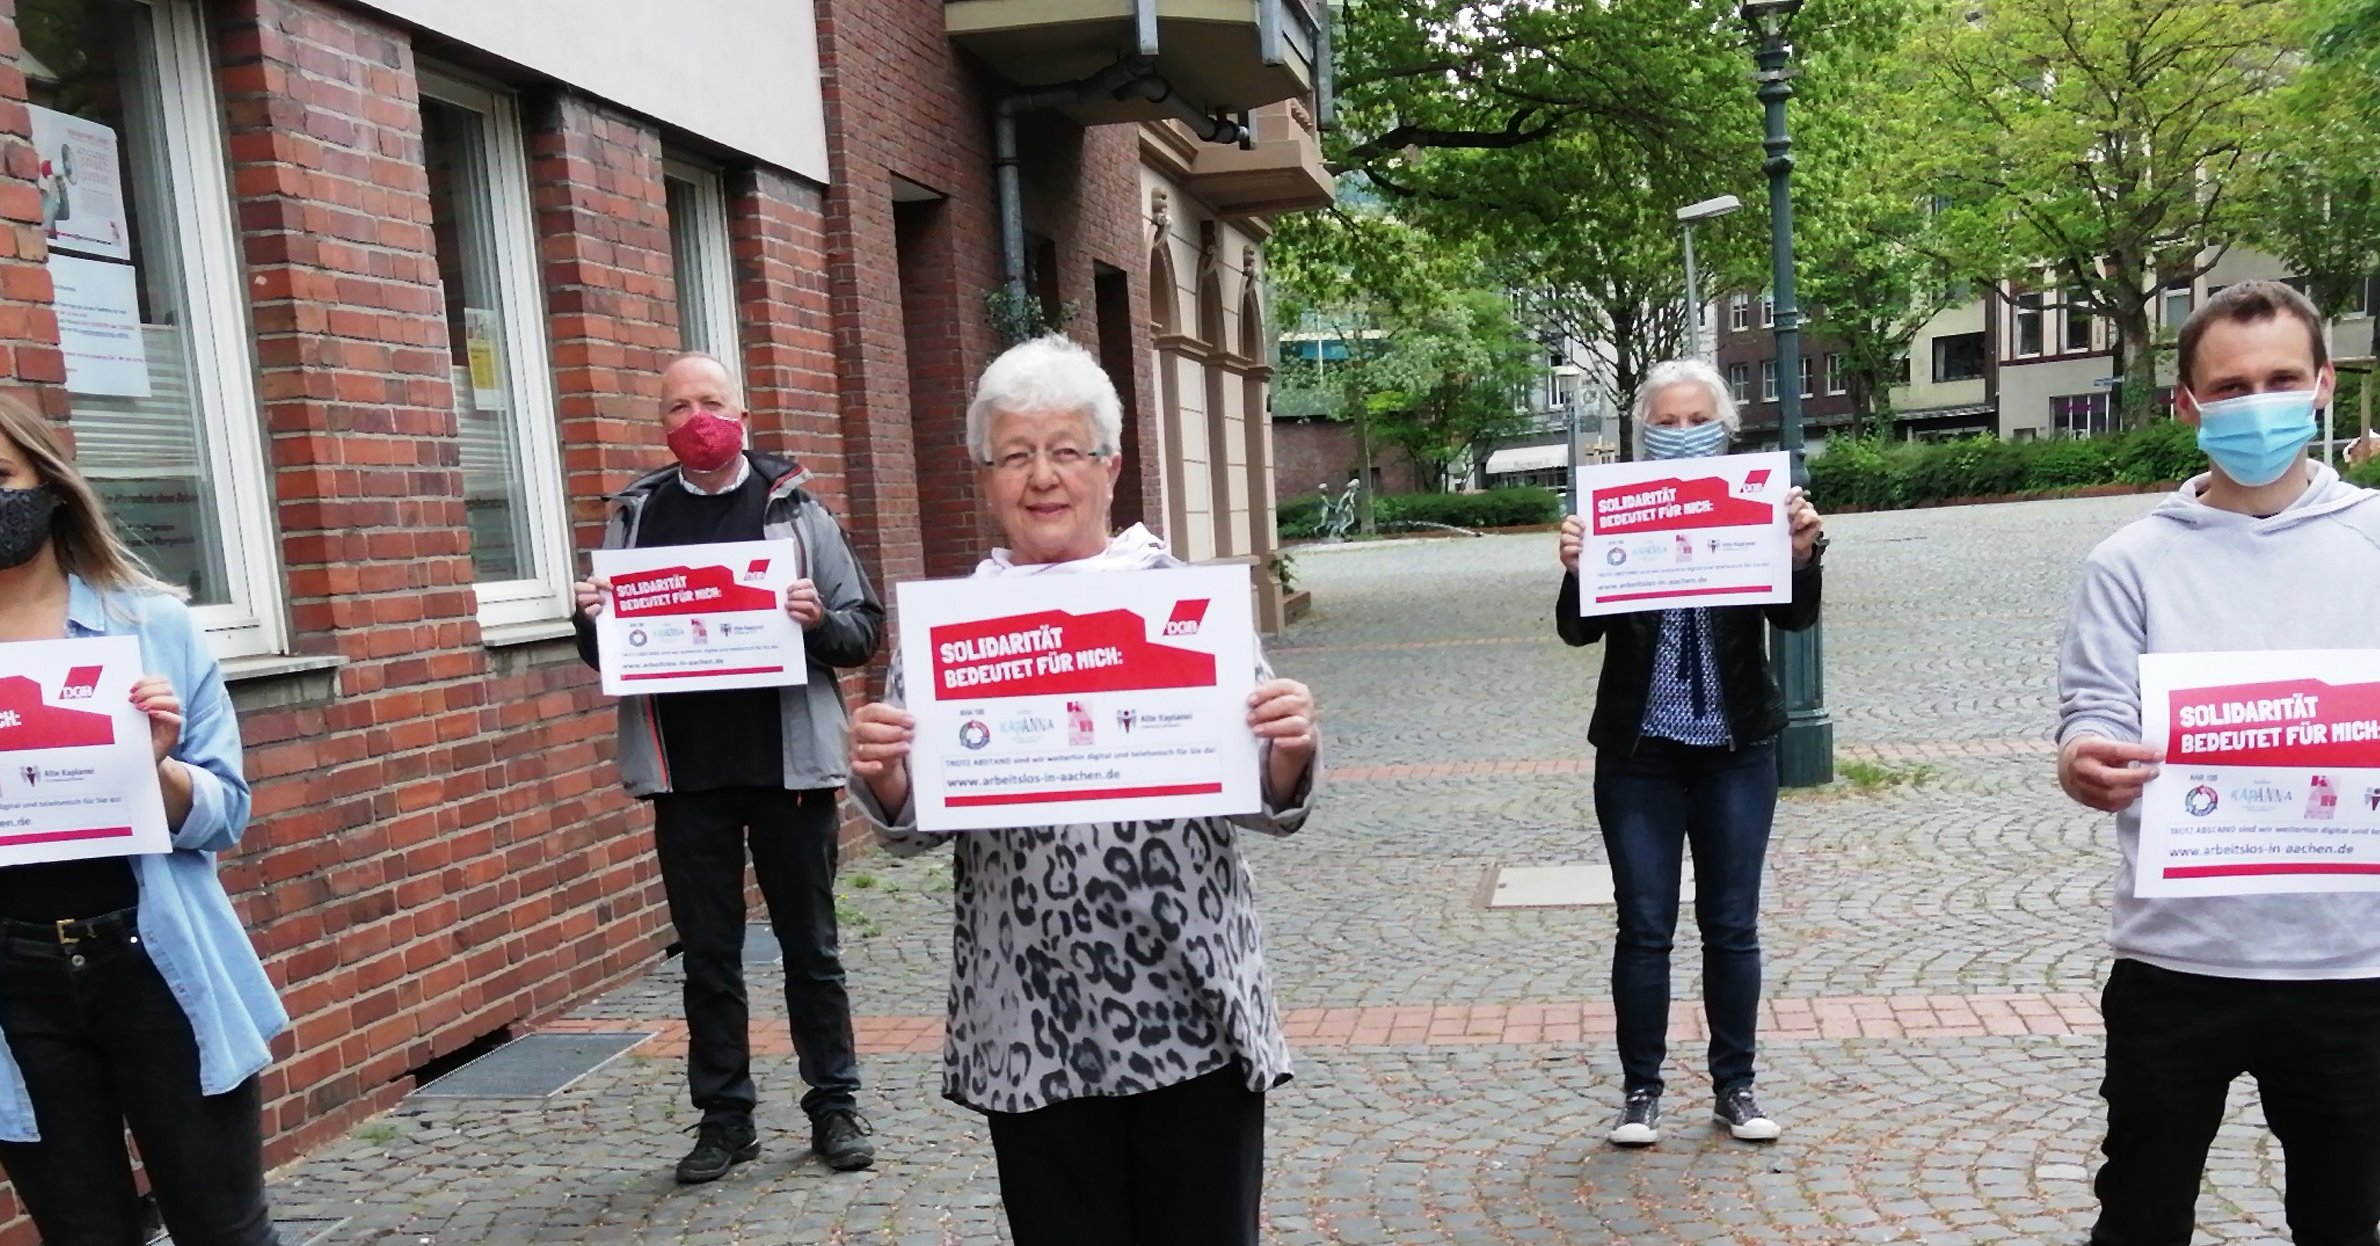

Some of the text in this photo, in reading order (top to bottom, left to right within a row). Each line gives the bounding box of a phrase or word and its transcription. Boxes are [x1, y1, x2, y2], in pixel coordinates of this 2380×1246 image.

[1598, 487, 1676, 513] SOLIDARITÄT
[1600, 500, 1714, 528] BEDEUTET FÜR MICH:
[616, 574, 687, 598] SOLIDARITÄT
[619, 587, 722, 611] BEDEUTET FÜR MICH:
[1167, 620, 1198, 635] DGB
[940, 624, 1063, 663] SOLIDARITÄT
[944, 647, 1123, 688] BEDEUTET FÜR MICH:
[64, 685, 92, 699] DGB
[2179, 692, 2319, 728] SOLIDARITÄT
[2181, 727, 2283, 754] BEDEUTET
[2286, 721, 2328, 746] FÜR
[1014, 756, 1030, 764] sind
[1087, 752, 1111, 761] digital
[1131, 749, 1174, 758] telefonisch
[946, 769, 1120, 787] www.arbeitslos-in-aachen.de
[2238, 825, 2256, 834] sind
[2320, 826, 2349, 836] digital
[2351, 827, 2369, 835] und
[2170, 843, 2354, 859] www.arbeitslos-in-aachen.de
